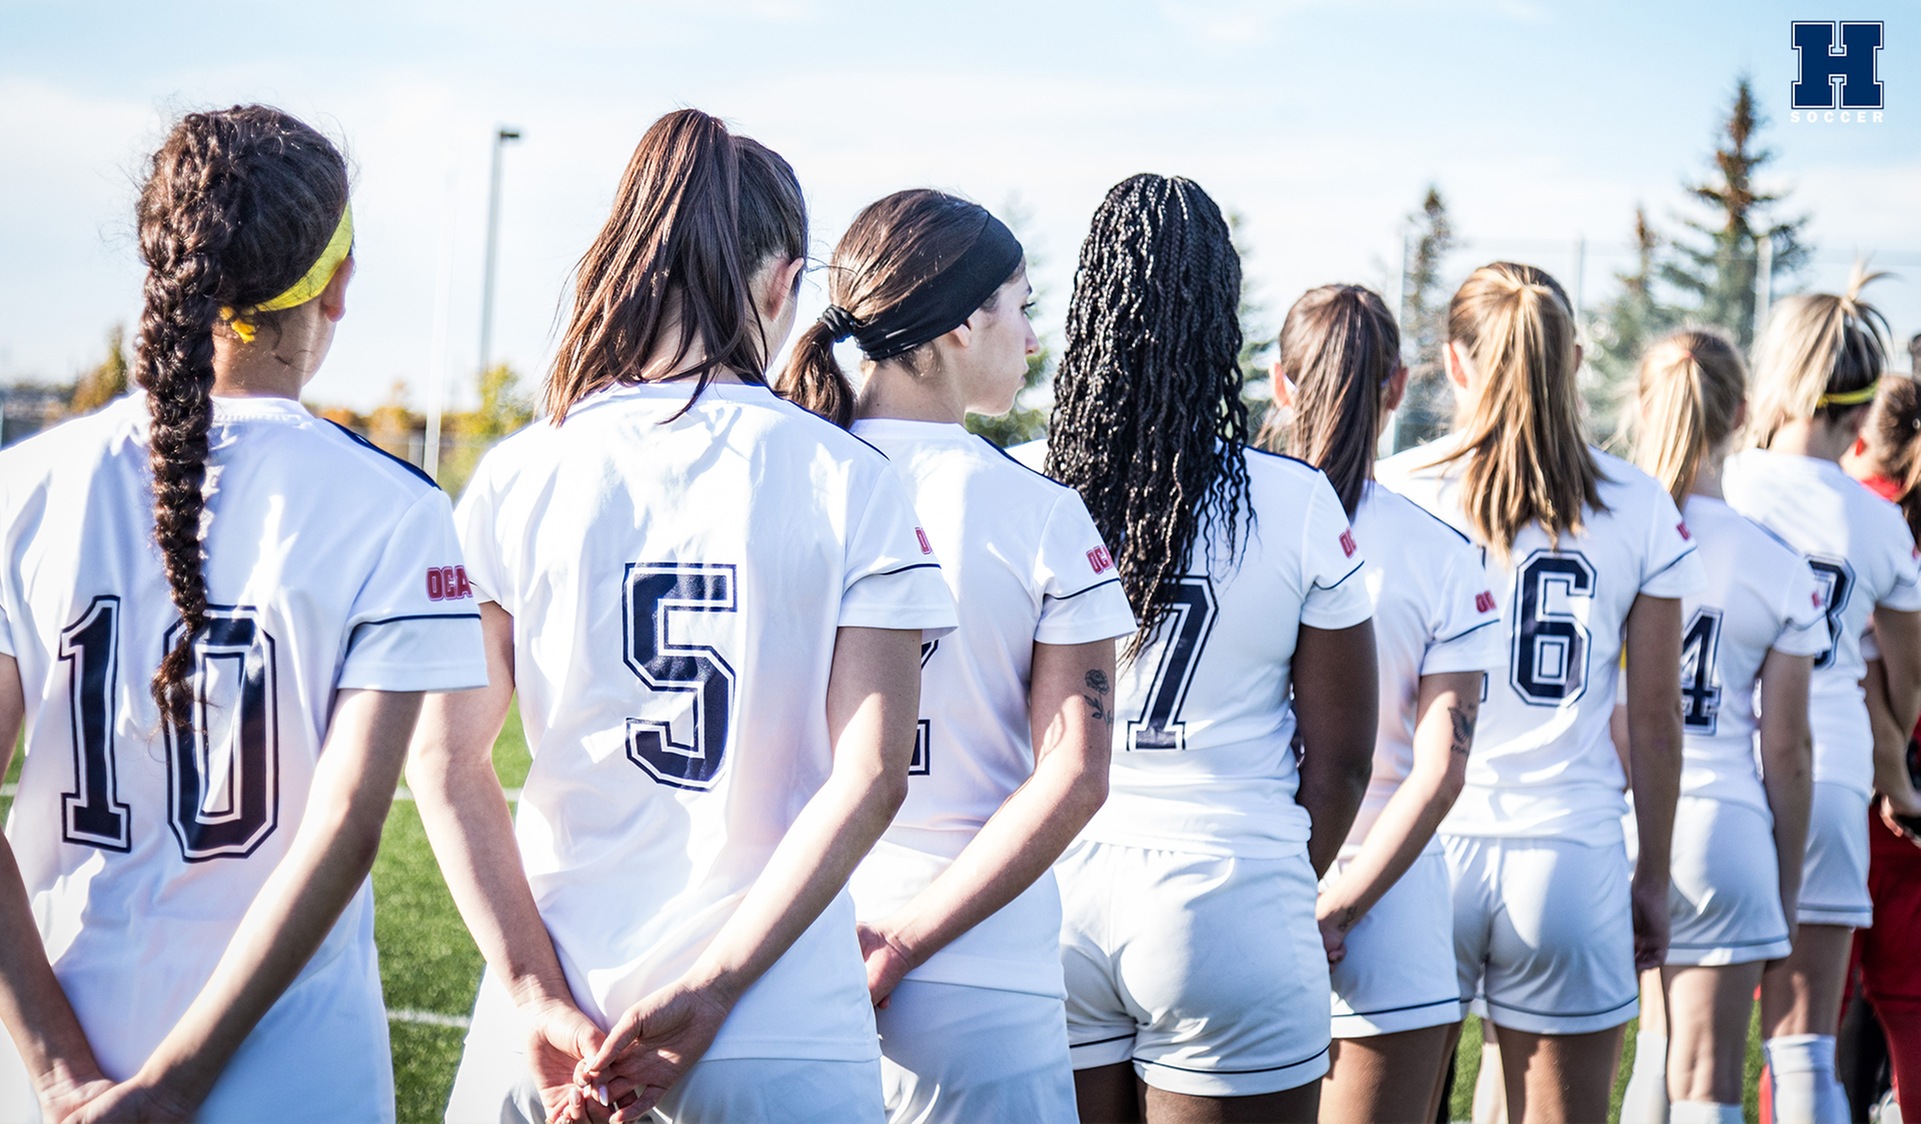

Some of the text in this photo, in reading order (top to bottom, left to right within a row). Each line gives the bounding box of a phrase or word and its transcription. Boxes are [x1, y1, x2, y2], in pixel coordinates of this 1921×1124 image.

[623, 562, 738, 792] 5
[1126, 574, 1219, 751] 7
[1511, 548, 1597, 708] 6
[1681, 605, 1724, 736] 4
[58, 594, 279, 863] 10
